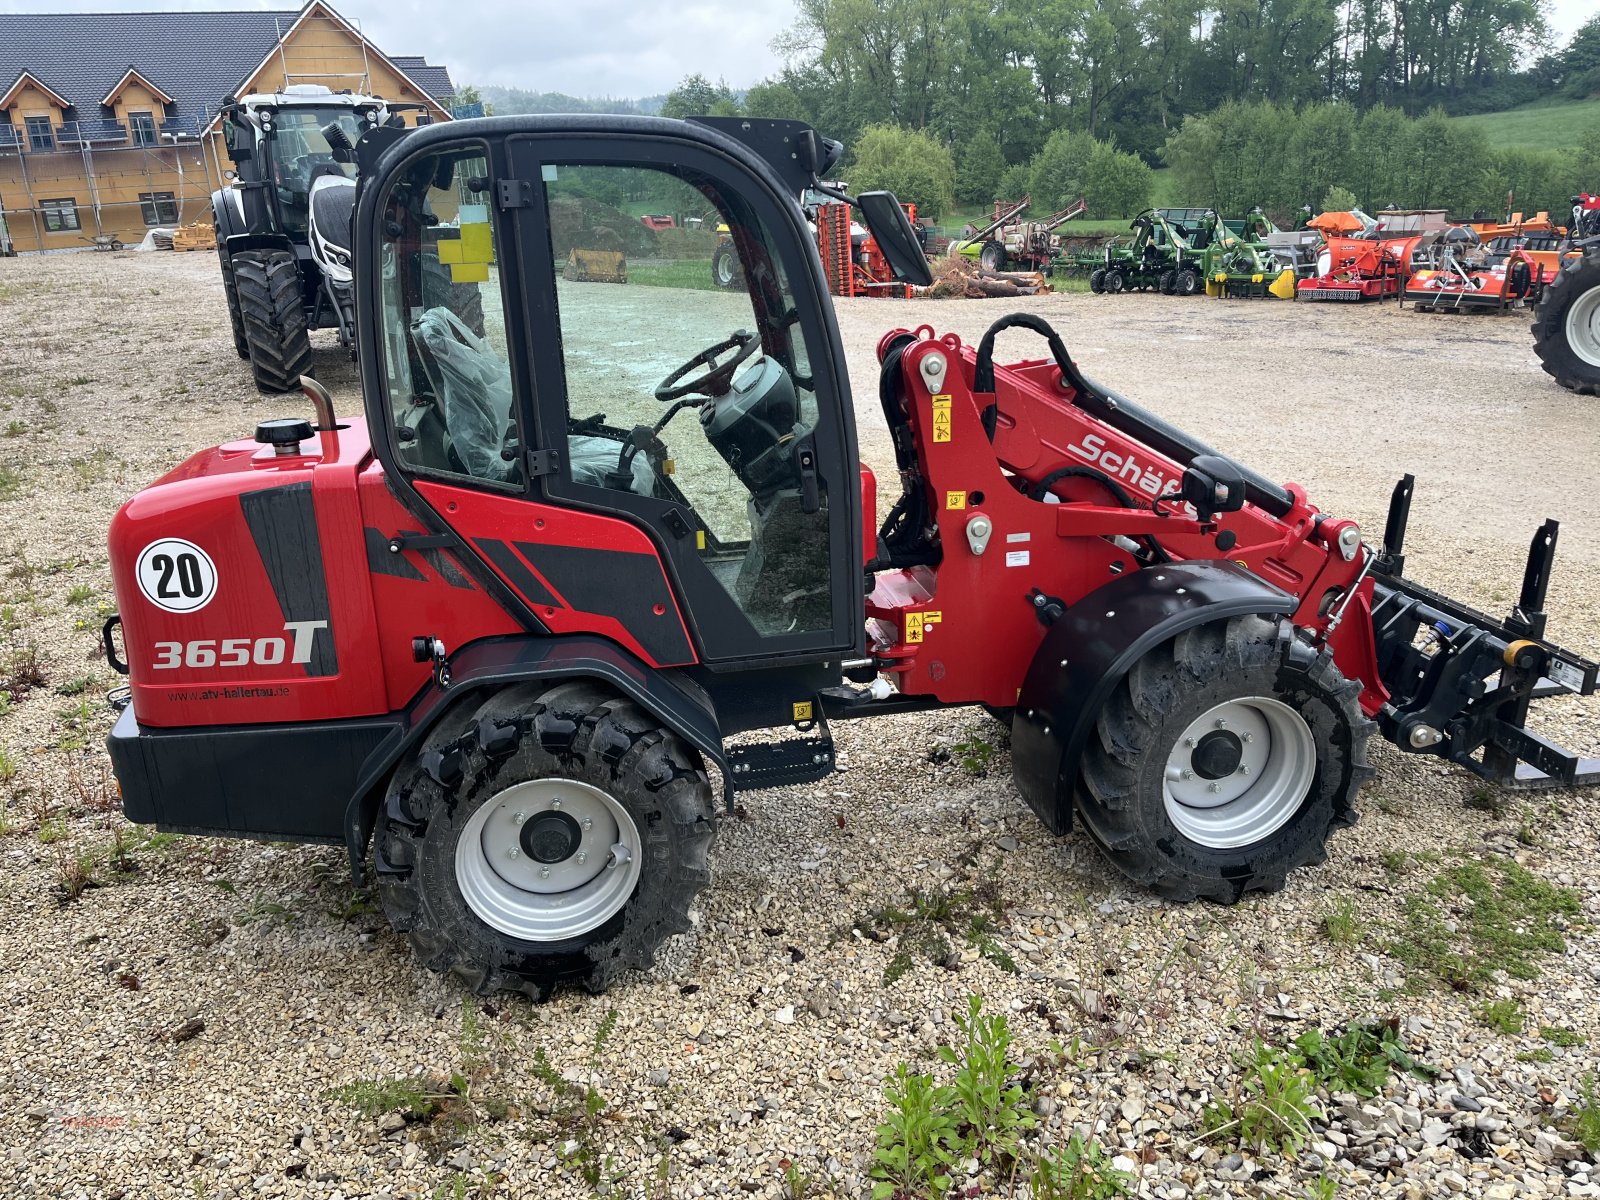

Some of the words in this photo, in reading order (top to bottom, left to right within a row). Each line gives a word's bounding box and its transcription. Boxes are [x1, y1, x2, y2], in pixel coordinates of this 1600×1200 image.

[152, 553, 204, 598] 20
[153, 620, 327, 669] 3650T
[168, 687, 290, 701] www.atv-hallertau.de
